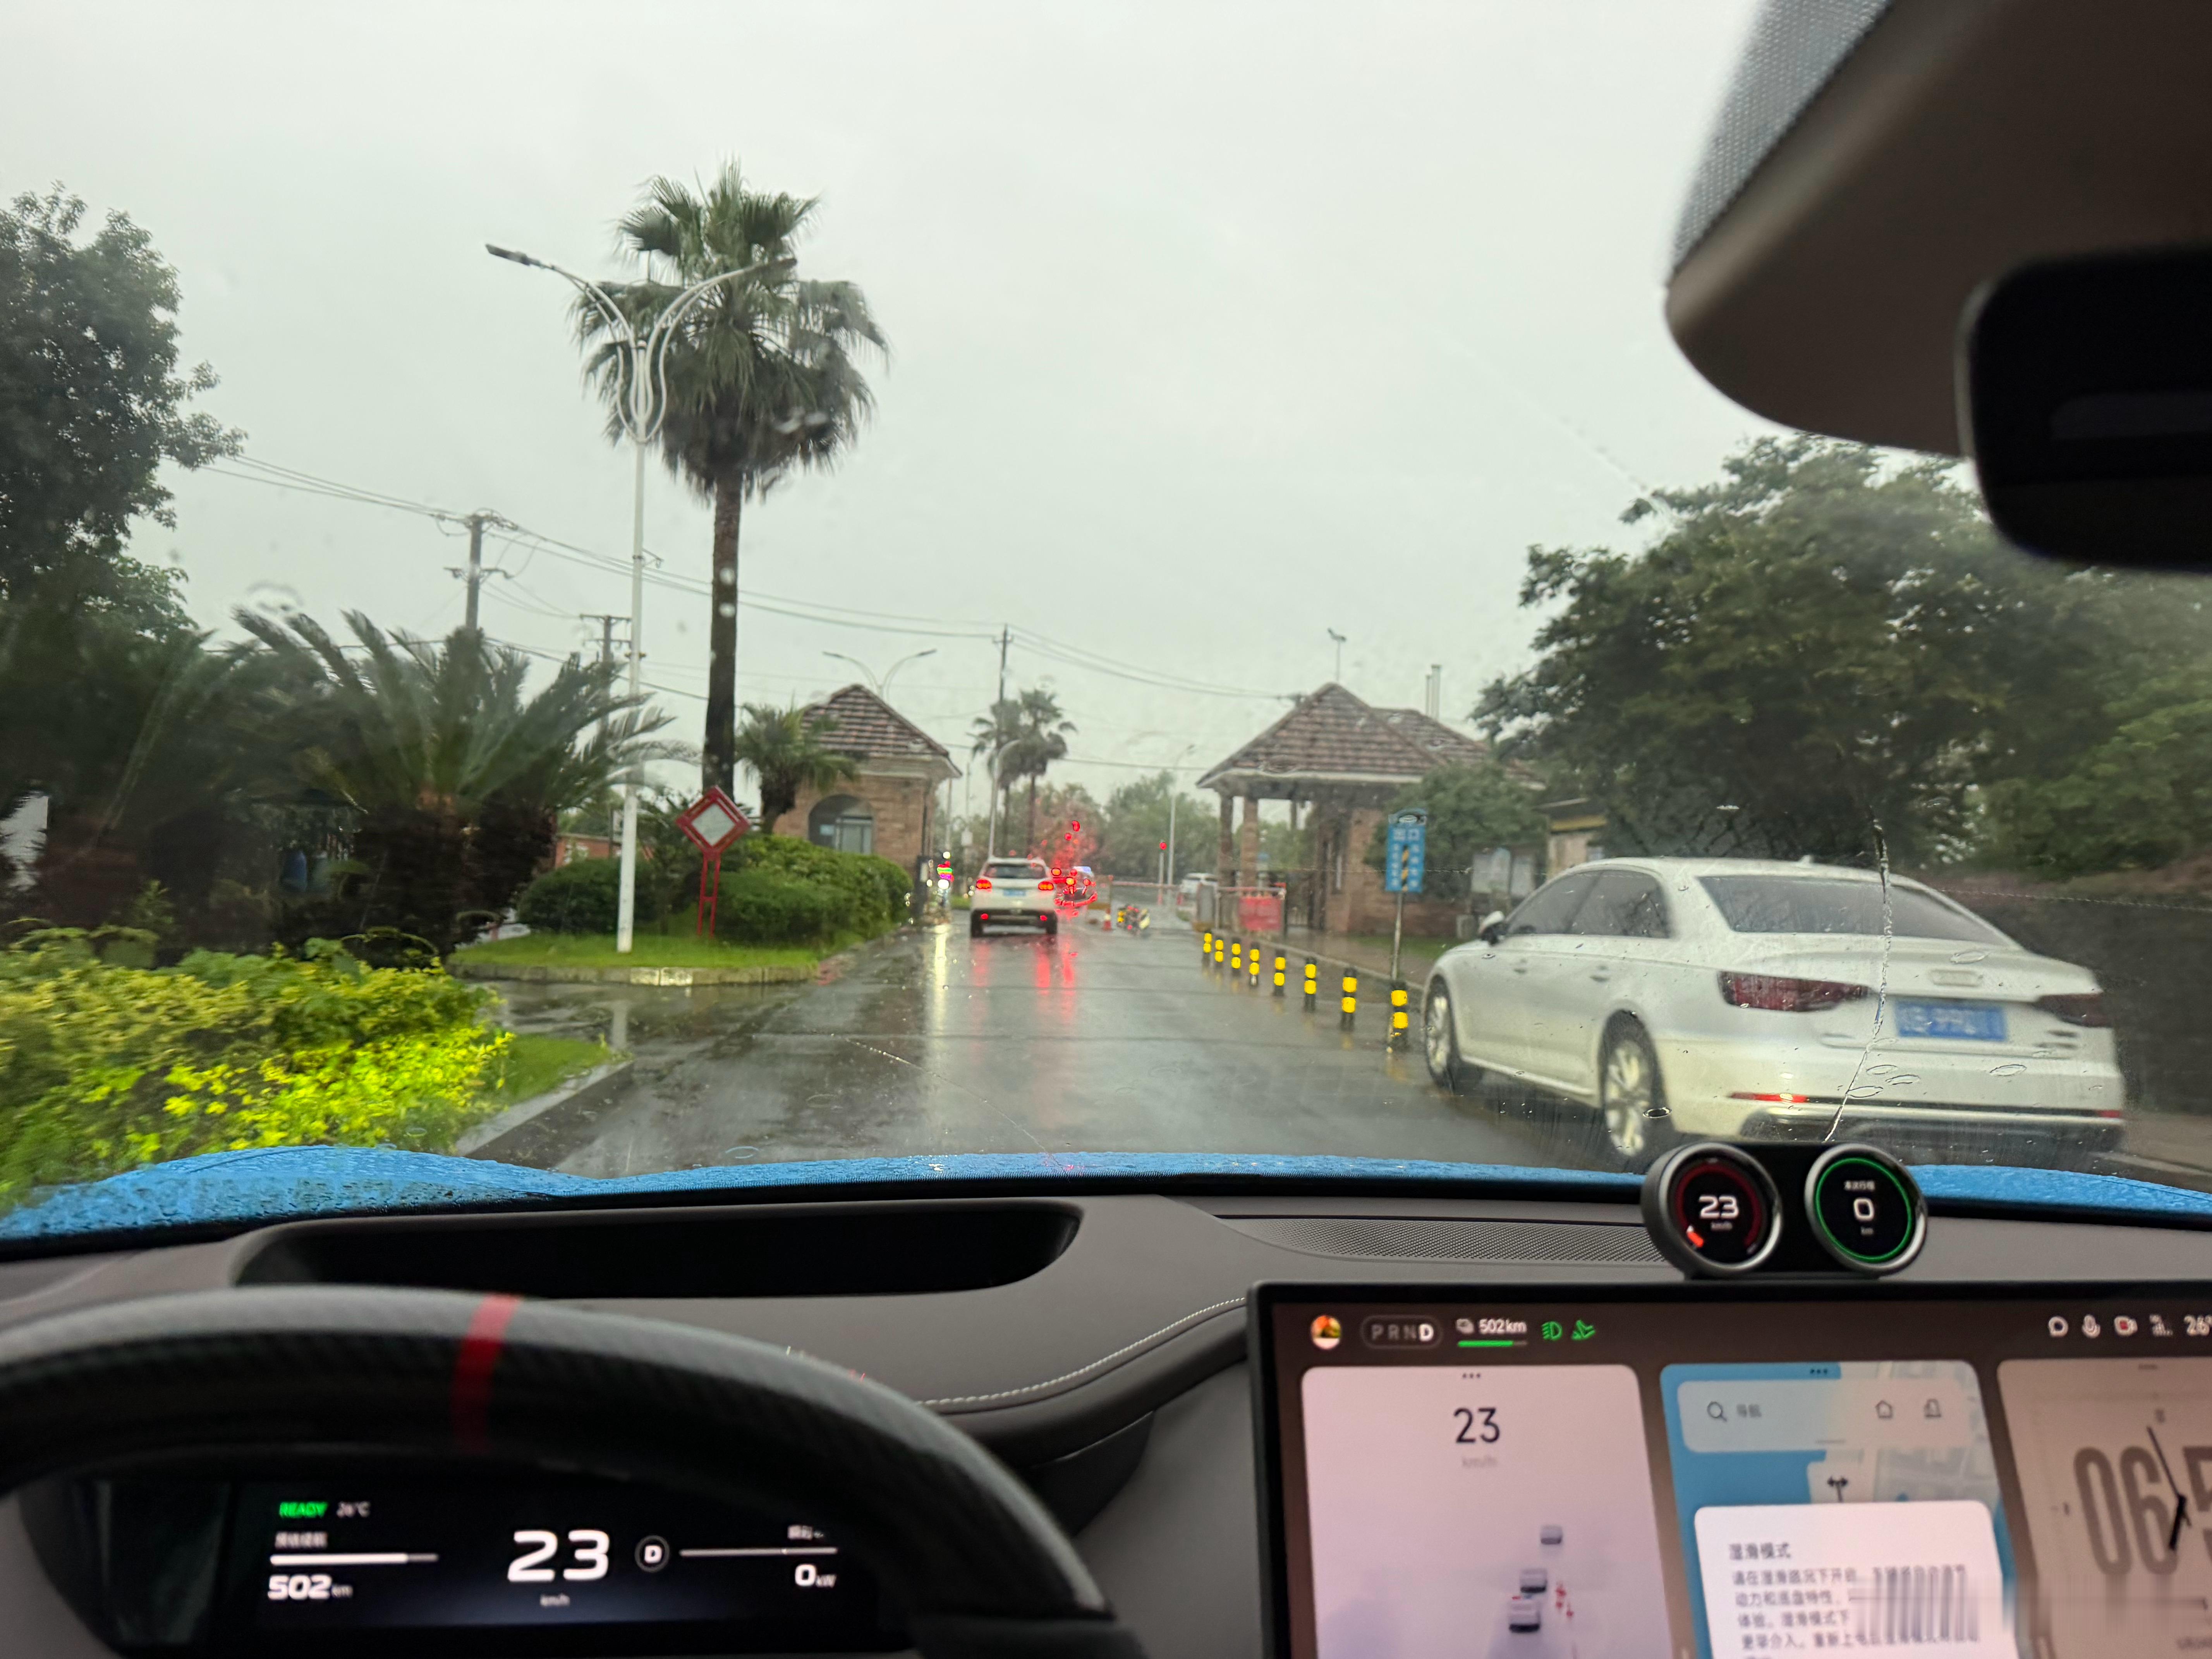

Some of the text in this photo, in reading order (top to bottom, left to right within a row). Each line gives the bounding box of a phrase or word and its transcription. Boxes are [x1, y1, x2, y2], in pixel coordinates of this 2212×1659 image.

[1698, 1195, 1739, 1219] 23
[1853, 1197, 1875, 1221] 0
[1453, 1407, 1500, 1443] 23
[280, 1502, 328, 1518] READY
[508, 1529, 610, 1582] 23
[644, 1545, 662, 1563] D
